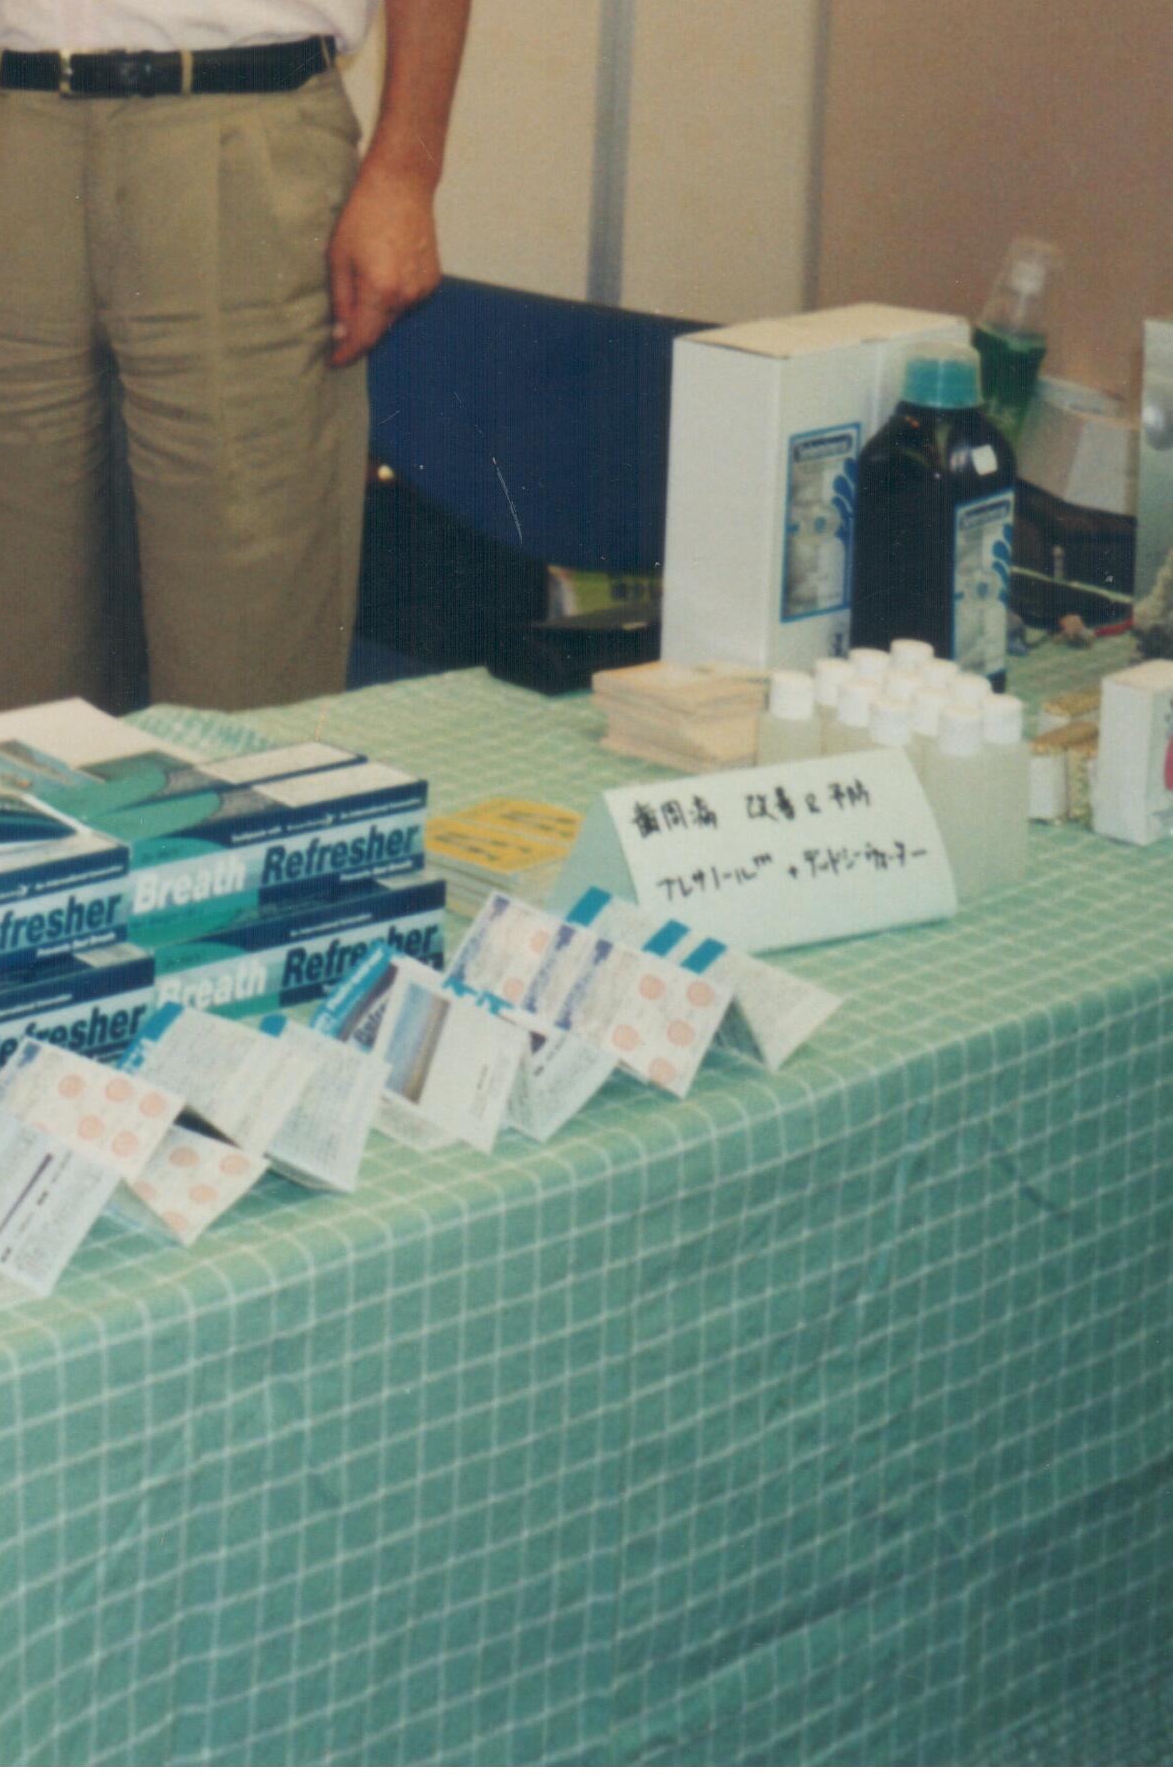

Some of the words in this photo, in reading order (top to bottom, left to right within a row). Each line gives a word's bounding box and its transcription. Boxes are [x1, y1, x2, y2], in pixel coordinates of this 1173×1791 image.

[132, 860, 247, 915] Breath
[261, 824, 421, 885] Refresher
[282, 924, 438, 988] Refreher
